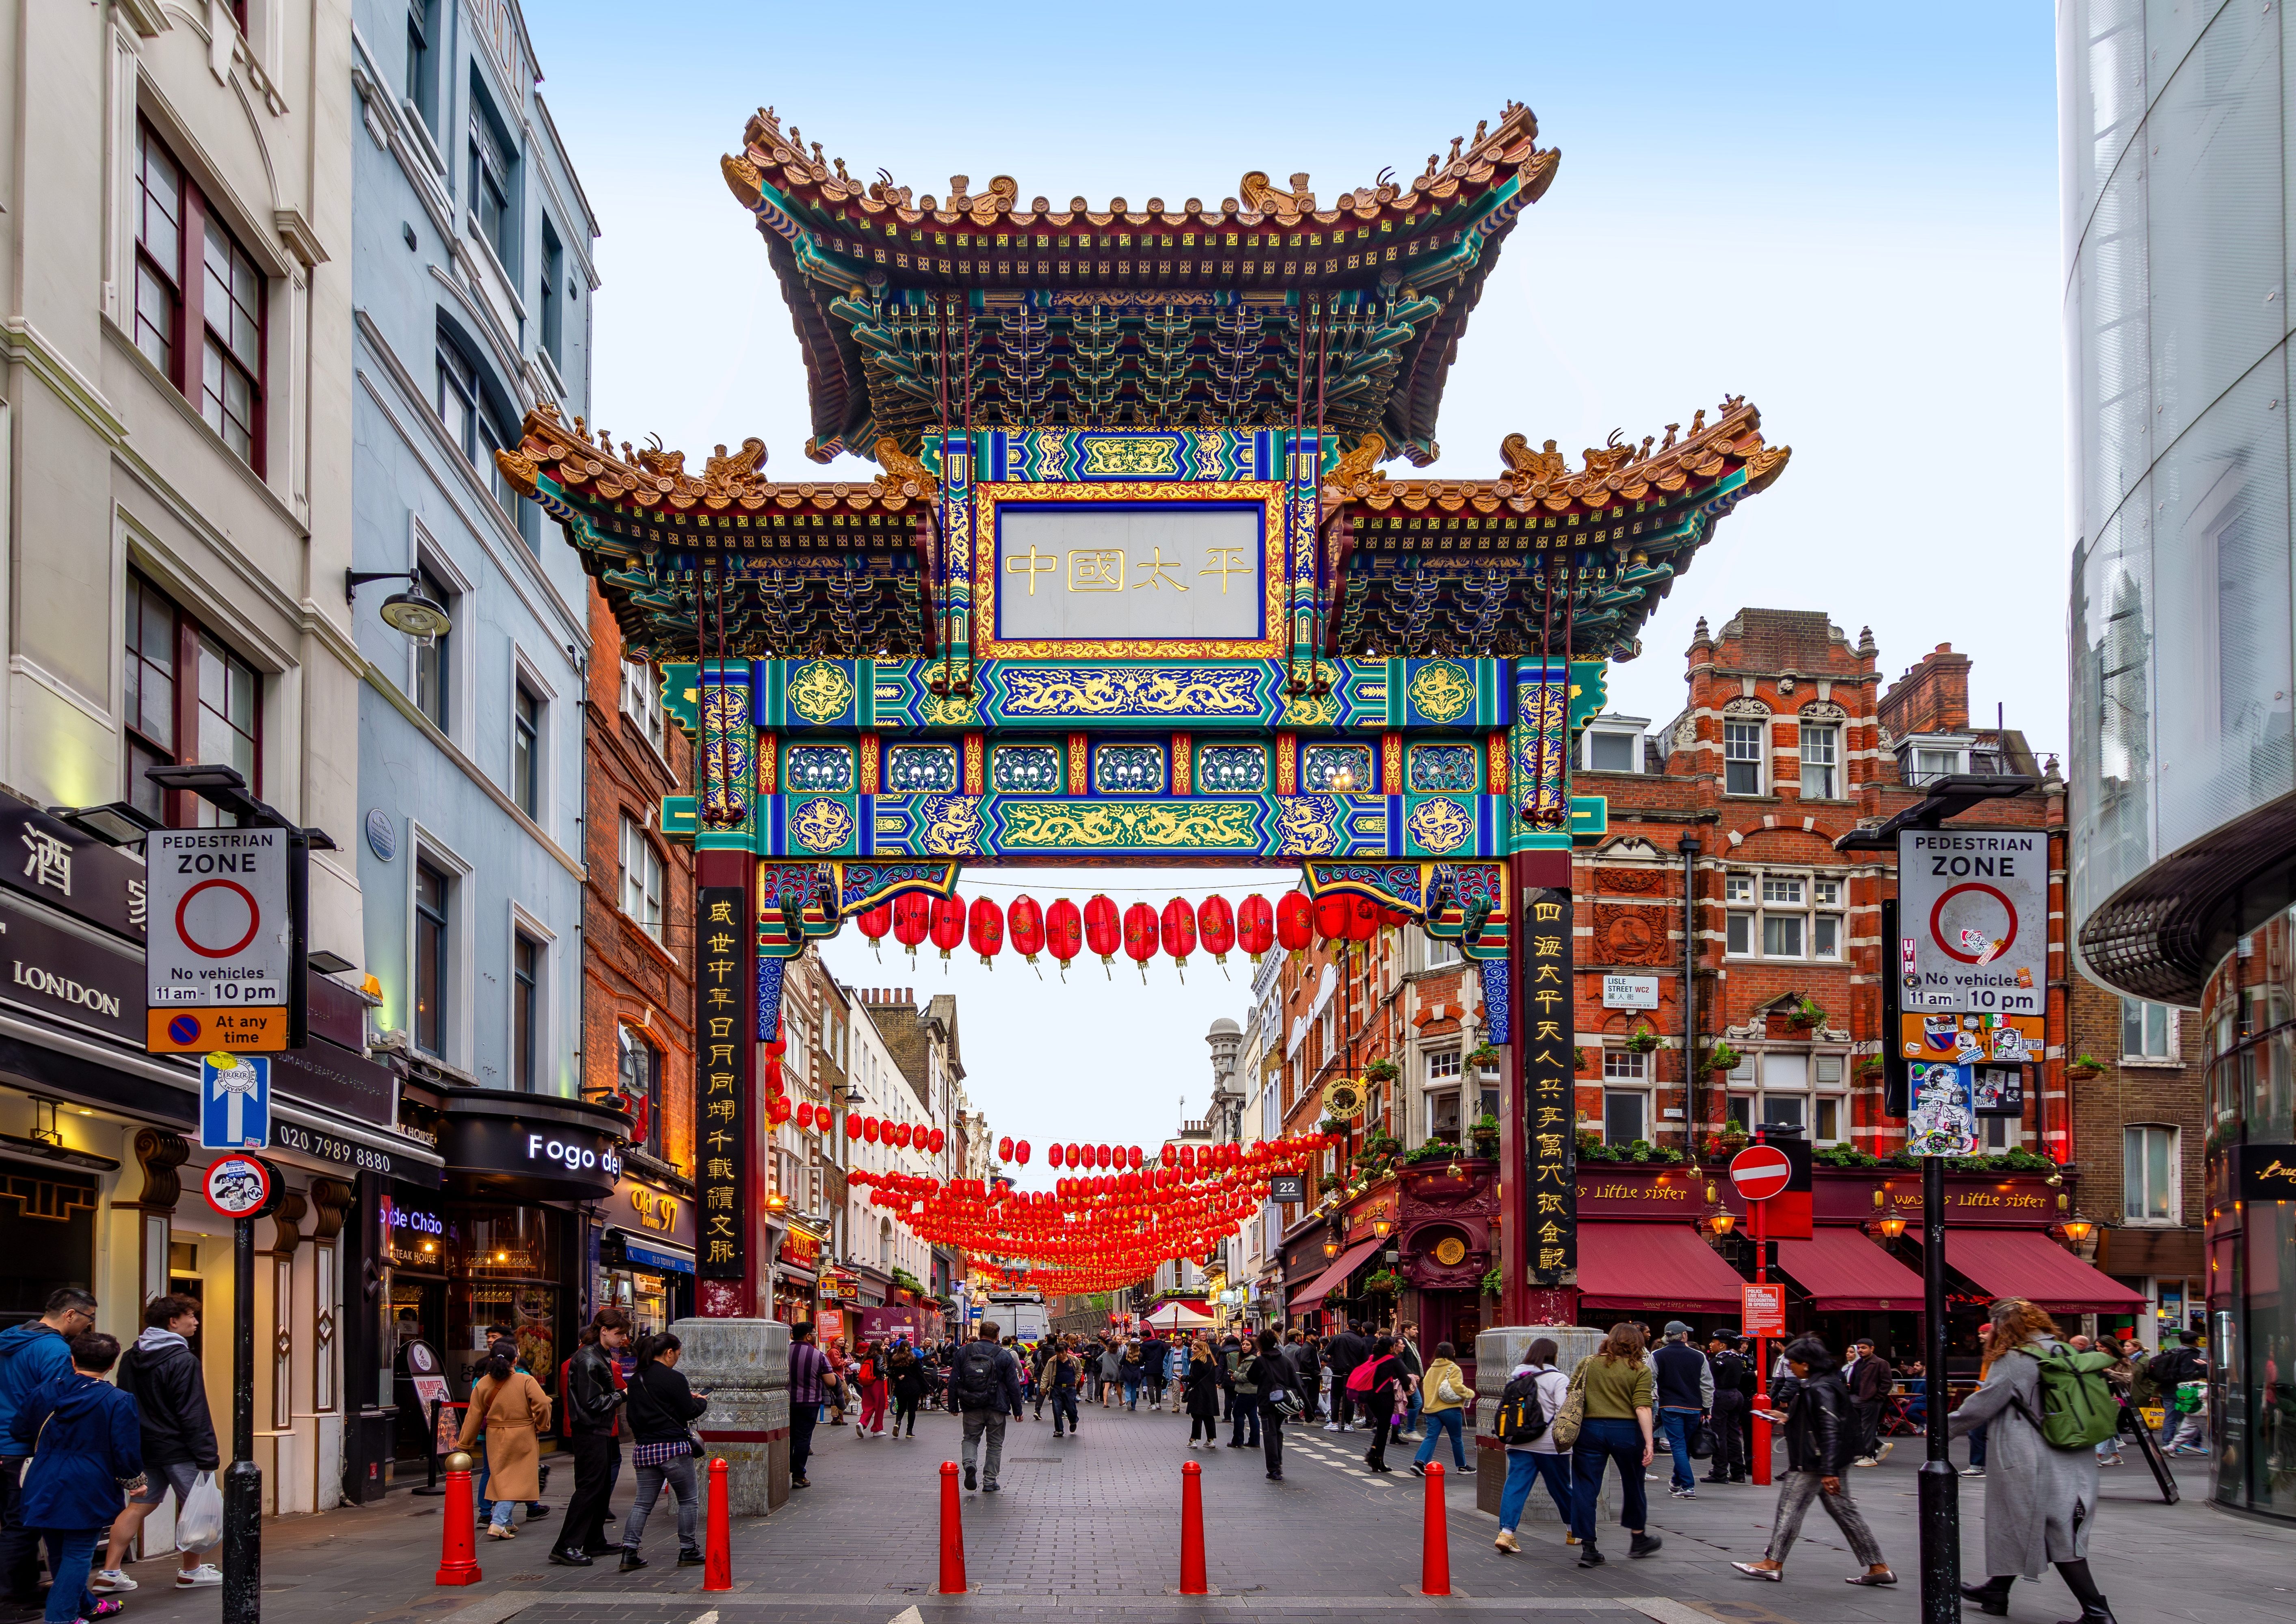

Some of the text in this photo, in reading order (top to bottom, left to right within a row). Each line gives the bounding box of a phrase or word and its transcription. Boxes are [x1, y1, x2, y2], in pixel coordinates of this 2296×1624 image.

[1006, 544, 1254, 596] 中國太平
[163, 835, 273, 849] PEDESTRIAN
[1916, 837, 2032, 851] PEDESTRIAN
[178, 853, 256, 873] ZONE
[1932, 856, 2014, 877] ZONE
[171, 967, 264, 980] No vehicles
[1926, 972, 1948, 985] No
[1954, 974, 2021, 987] vehicles
[13, 961, 120, 1017] LONDON
[157, 987, 172, 999] 11
[174, 991, 197, 999] am
[214, 983, 238, 999] 10
[244, 987, 275, 1002] pm
[1911, 992, 1923, 1004] 11
[1929, 996, 1952, 1005] am
[1971, 991, 1995, 1007] 10
[2002, 996, 2033, 1010] pm
[216, 1016, 267, 1030] At any
[224, 1031, 259, 1043] time
[278, 1054, 294, 1065] SUM
[295, 1058, 313, 1071] AND
[314, 1065, 347, 1085] SEAFOOD
[408, 1126, 434, 1145] HOUSE
[281, 1126, 390, 1172] 020 7989 8880
[529, 1134, 595, 1169] Fogo
[603, 1149, 618, 1174] de
[1280, 1182, 1295, 1192] 22
[631, 1190, 652, 1214] Old
[411, 1212, 442, 1234] Chão
[641, 1211, 659, 1230] Town
[414, 1252, 436, 1264] HOUSE
[660, 1257, 671, 1267] TOWN
[417, 1380, 444, 1390] UNLIMITED
[422, 1389, 437, 1397] BUFFET
